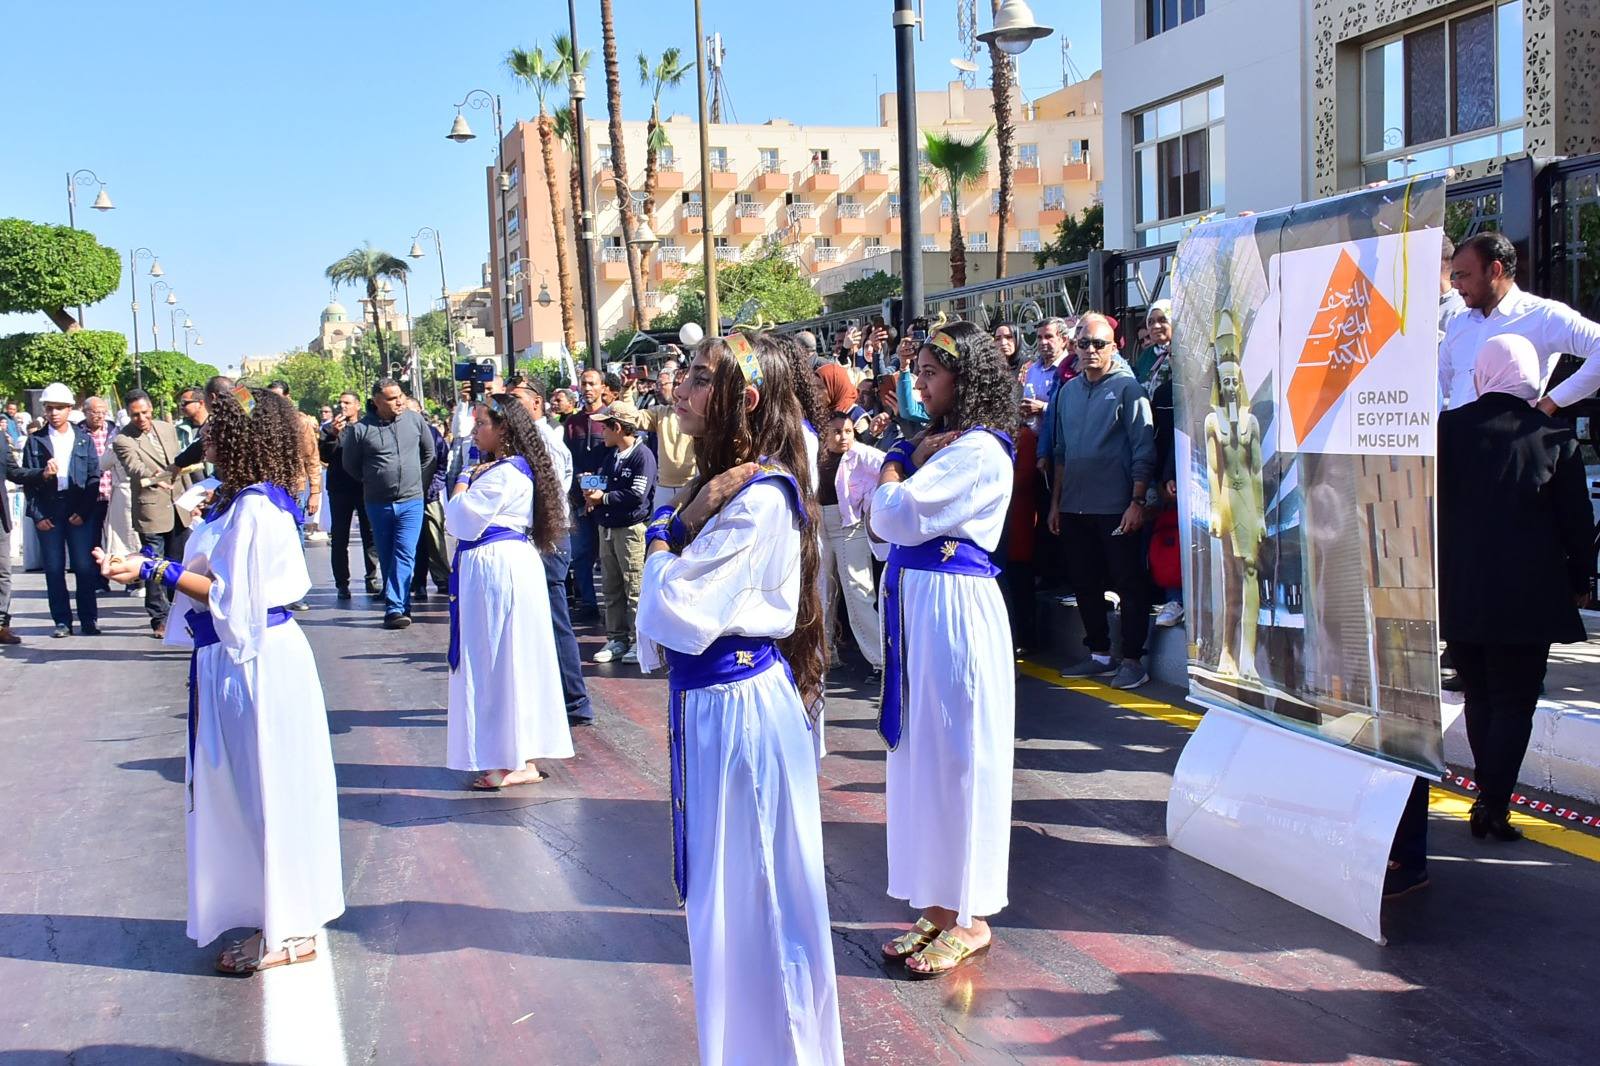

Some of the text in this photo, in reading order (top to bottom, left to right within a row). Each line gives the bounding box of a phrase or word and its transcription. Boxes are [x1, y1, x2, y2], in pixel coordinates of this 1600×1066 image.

[1317, 279, 1371, 312] المتحف
[1297, 337, 1371, 370] الكبير
[1357, 390, 1409, 405] GRAND
[1357, 411, 1430, 426] EGYPTIAN
[1357, 434, 1419, 448] MUSEUM
